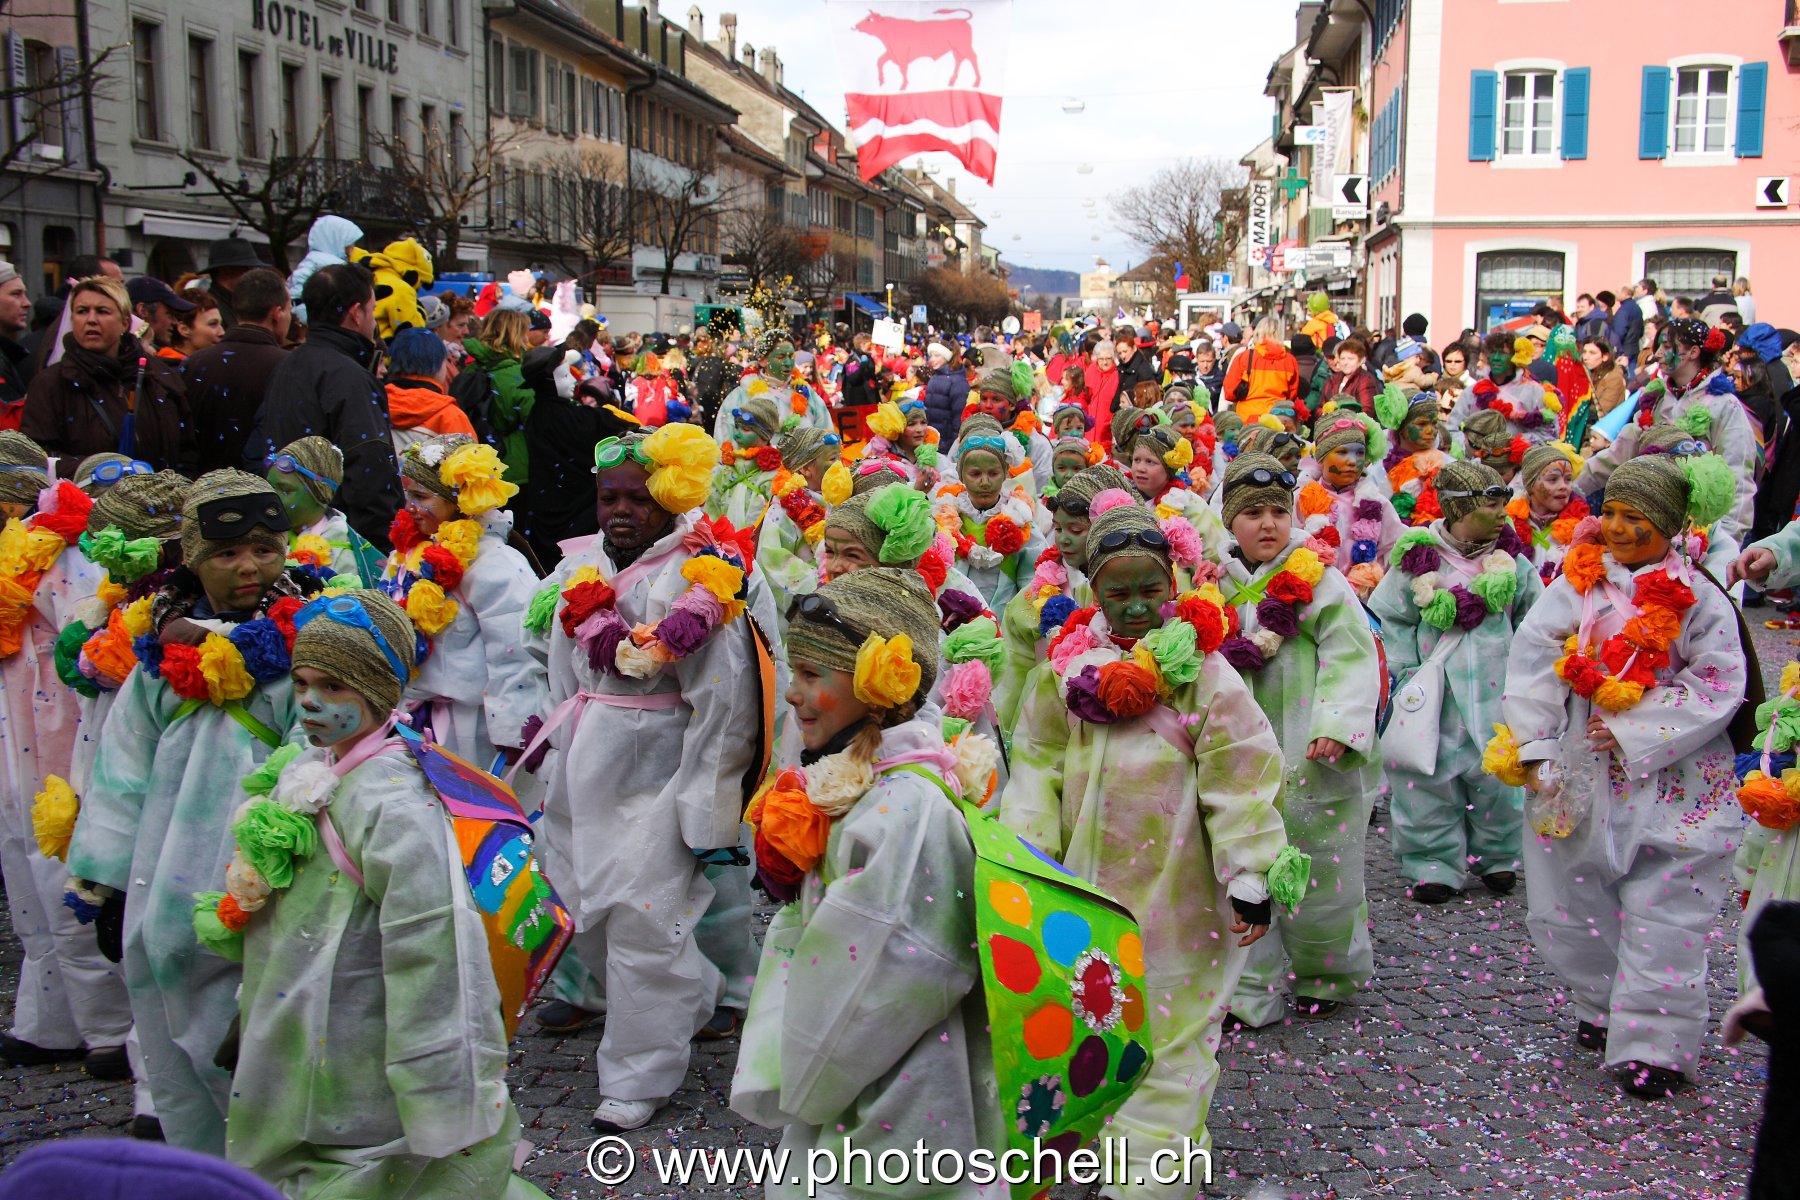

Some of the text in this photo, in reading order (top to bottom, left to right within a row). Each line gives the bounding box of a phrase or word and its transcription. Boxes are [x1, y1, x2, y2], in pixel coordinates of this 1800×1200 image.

[252, 0, 399, 74] HOTEL DE VILLE
[1253, 184, 1267, 244] MANOR
[1335, 208, 1364, 217] Banque
